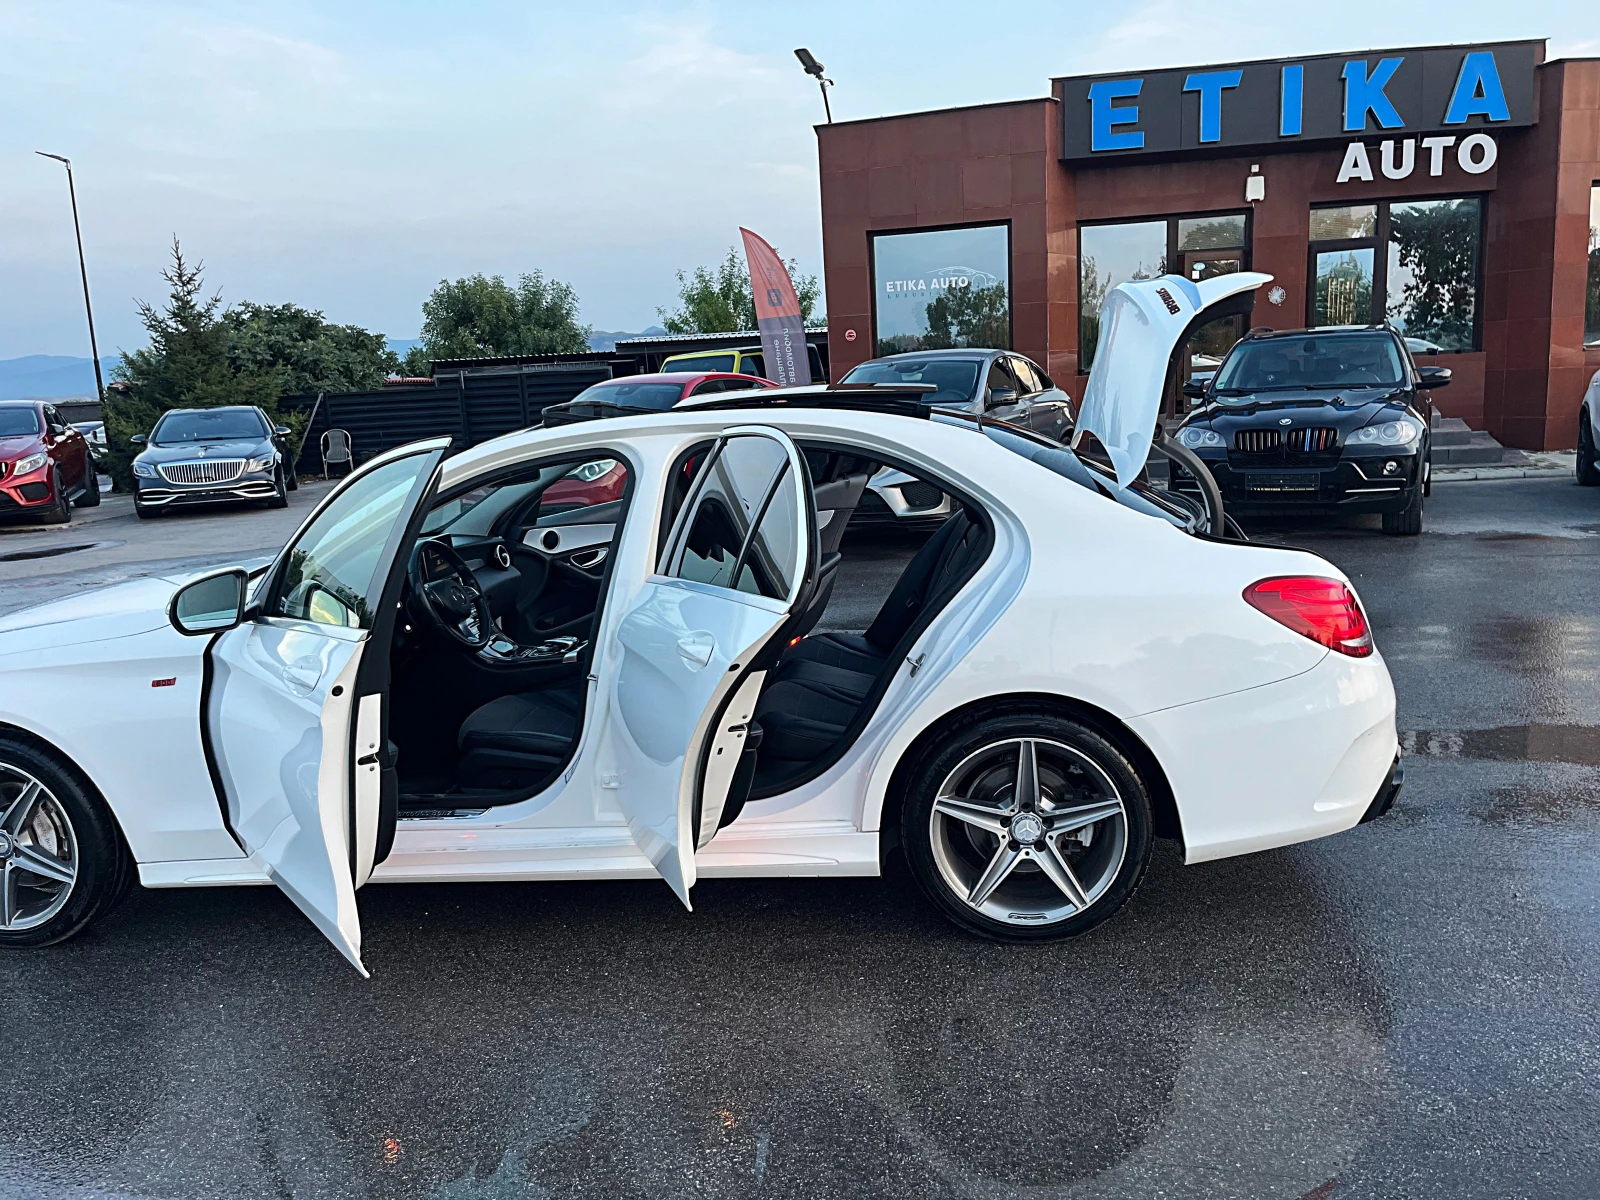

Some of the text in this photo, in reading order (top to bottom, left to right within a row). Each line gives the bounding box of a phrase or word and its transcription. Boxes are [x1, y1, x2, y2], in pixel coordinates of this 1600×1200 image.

[1087, 50, 1511, 152] ETIKA
[1336, 133, 1498, 183] AUTO
[885, 280, 926, 293] ETIKA
[930, 276, 969, 289] AUTO
